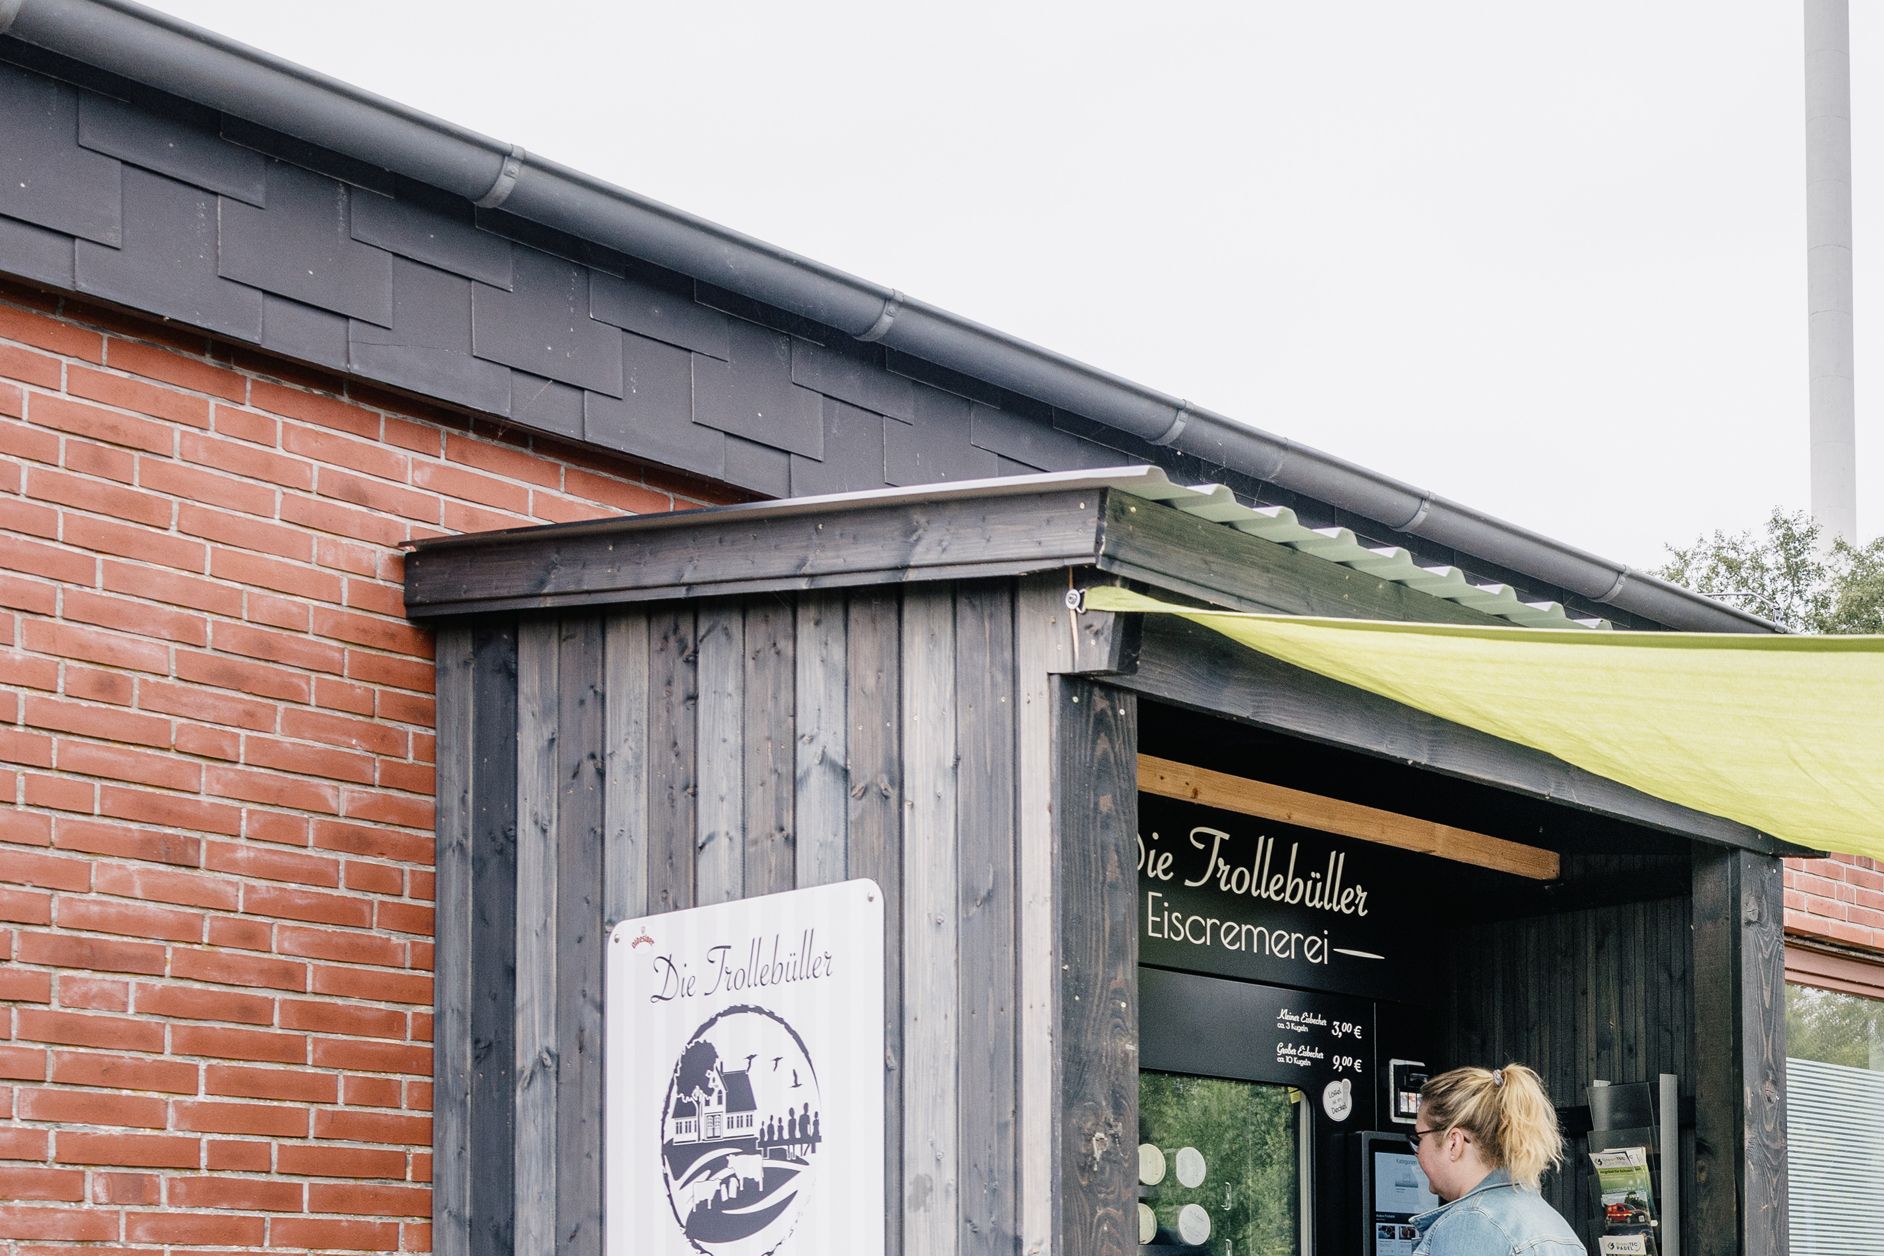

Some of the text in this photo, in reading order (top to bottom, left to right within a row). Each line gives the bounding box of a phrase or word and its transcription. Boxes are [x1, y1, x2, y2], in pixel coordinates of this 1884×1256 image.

[1184, 826, 1369, 917] Trollebüller
[1147, 891, 1329, 965] Eiscremerei
[650, 928, 833, 1003] Die Trollebüller
[1277, 1008, 1327, 1026] Kleiner Eisbecher
[1285, 1022, 1291, 1030] 3
[1291, 1022, 1309, 1033] Kugeln
[1331, 1021, 1362, 1039] 3,00 €
[1297, 1045, 1324, 1059] Eisbecher
[1285, 1056, 1293, 1064] 10
[1293, 1057, 1312, 1067] Kugeln
[1332, 1055, 1362, 1072] 9,00 €
